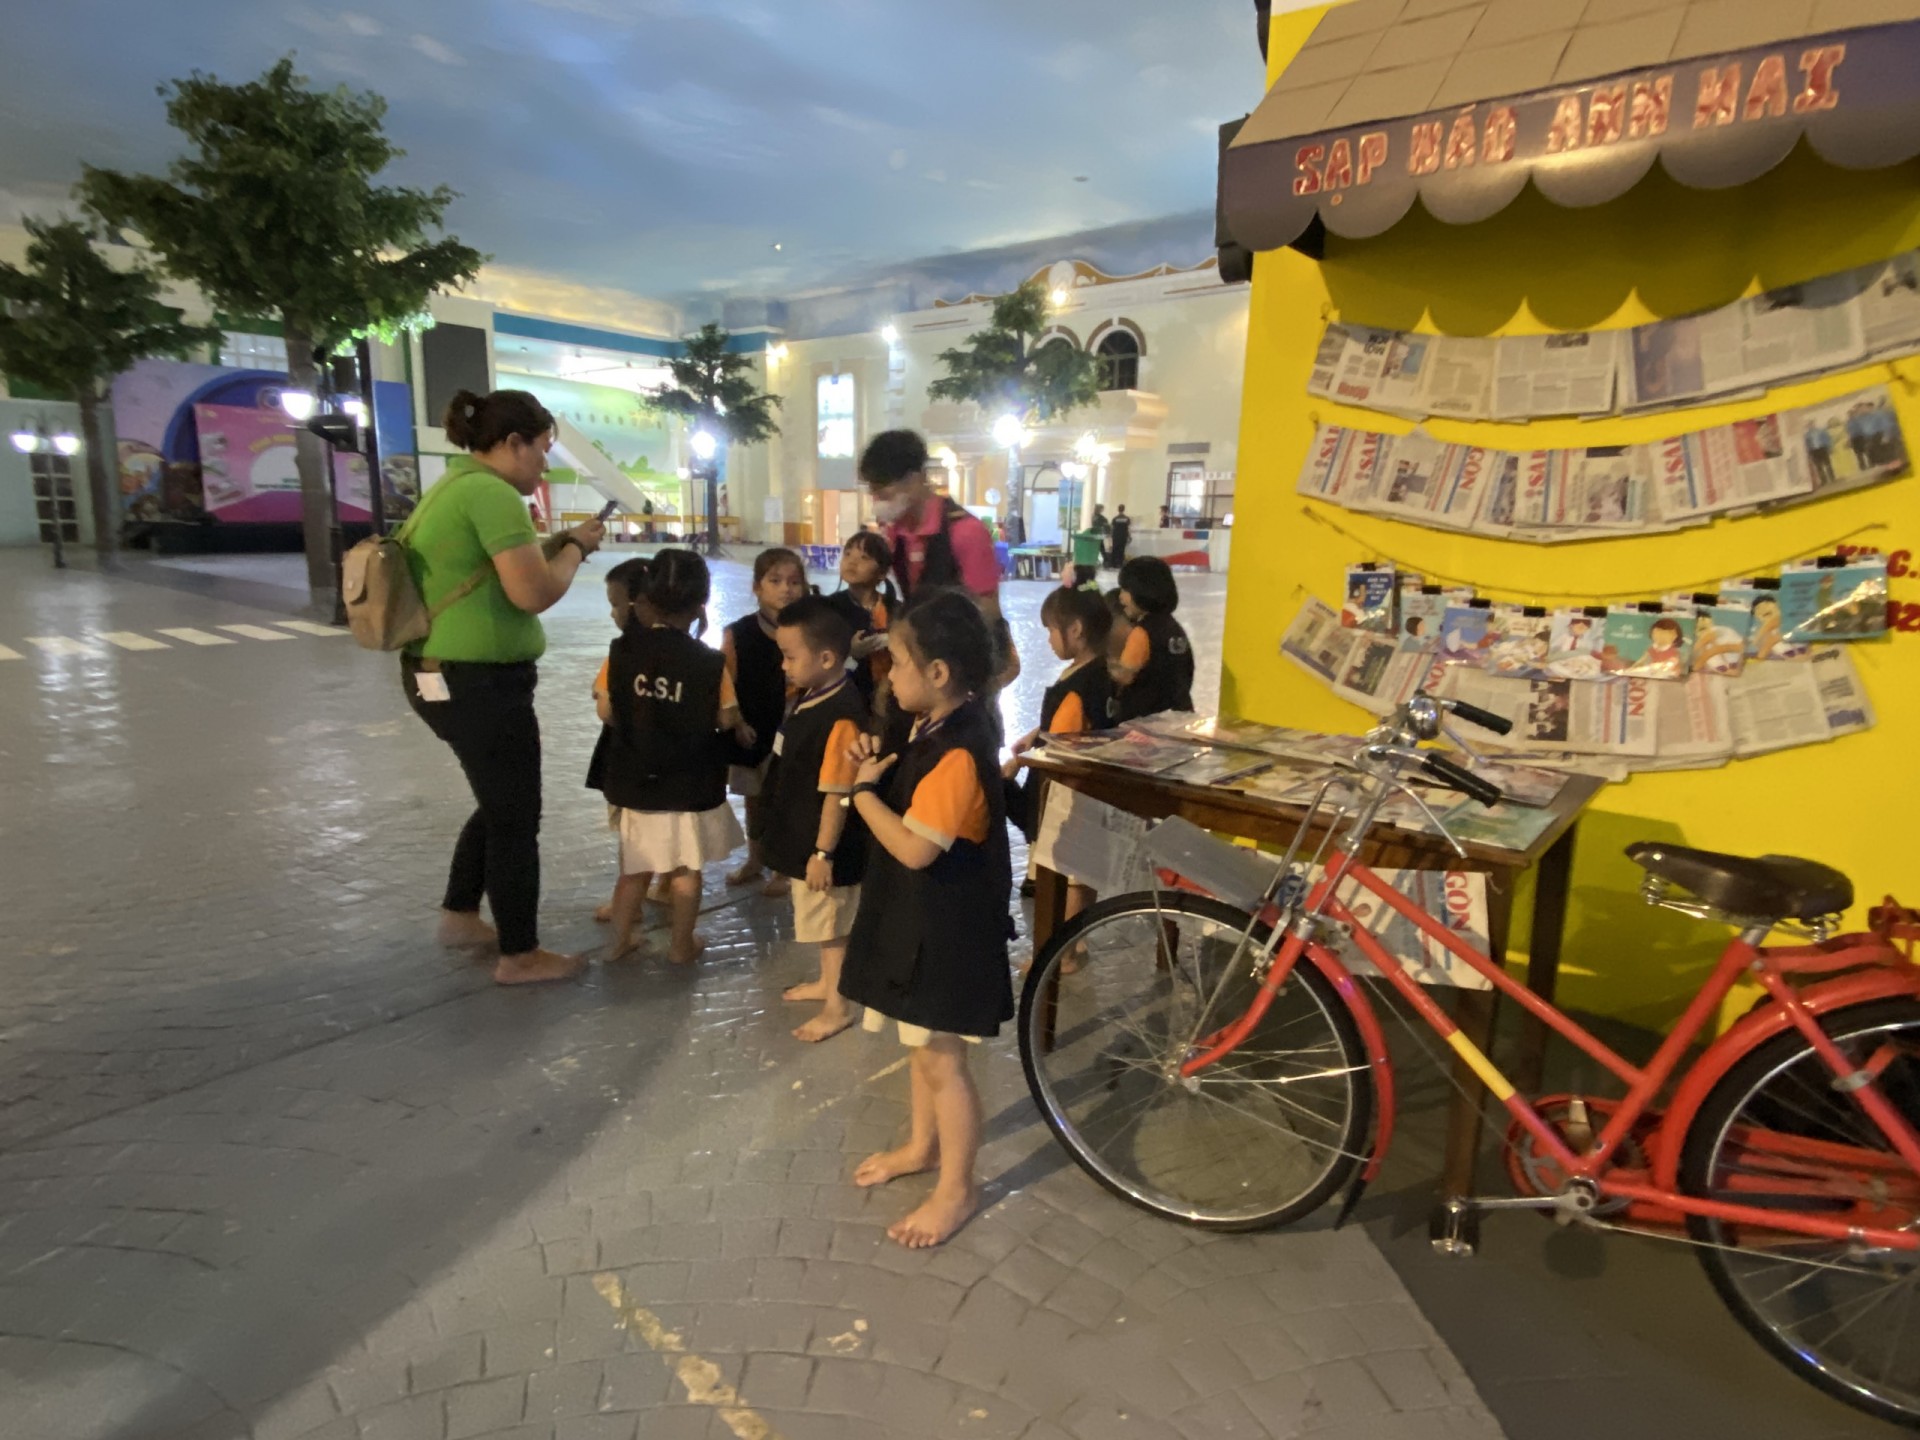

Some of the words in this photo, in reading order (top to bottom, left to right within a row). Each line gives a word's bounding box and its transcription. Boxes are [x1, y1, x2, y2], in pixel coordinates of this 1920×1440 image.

[1293, 131, 1388, 206] SẠP
[1408, 103, 1518, 175] BÁO
[1545, 74, 1675, 155] ANH
[1692, 43, 1846, 129] HAI
[633, 673, 682, 703] C.S.I
